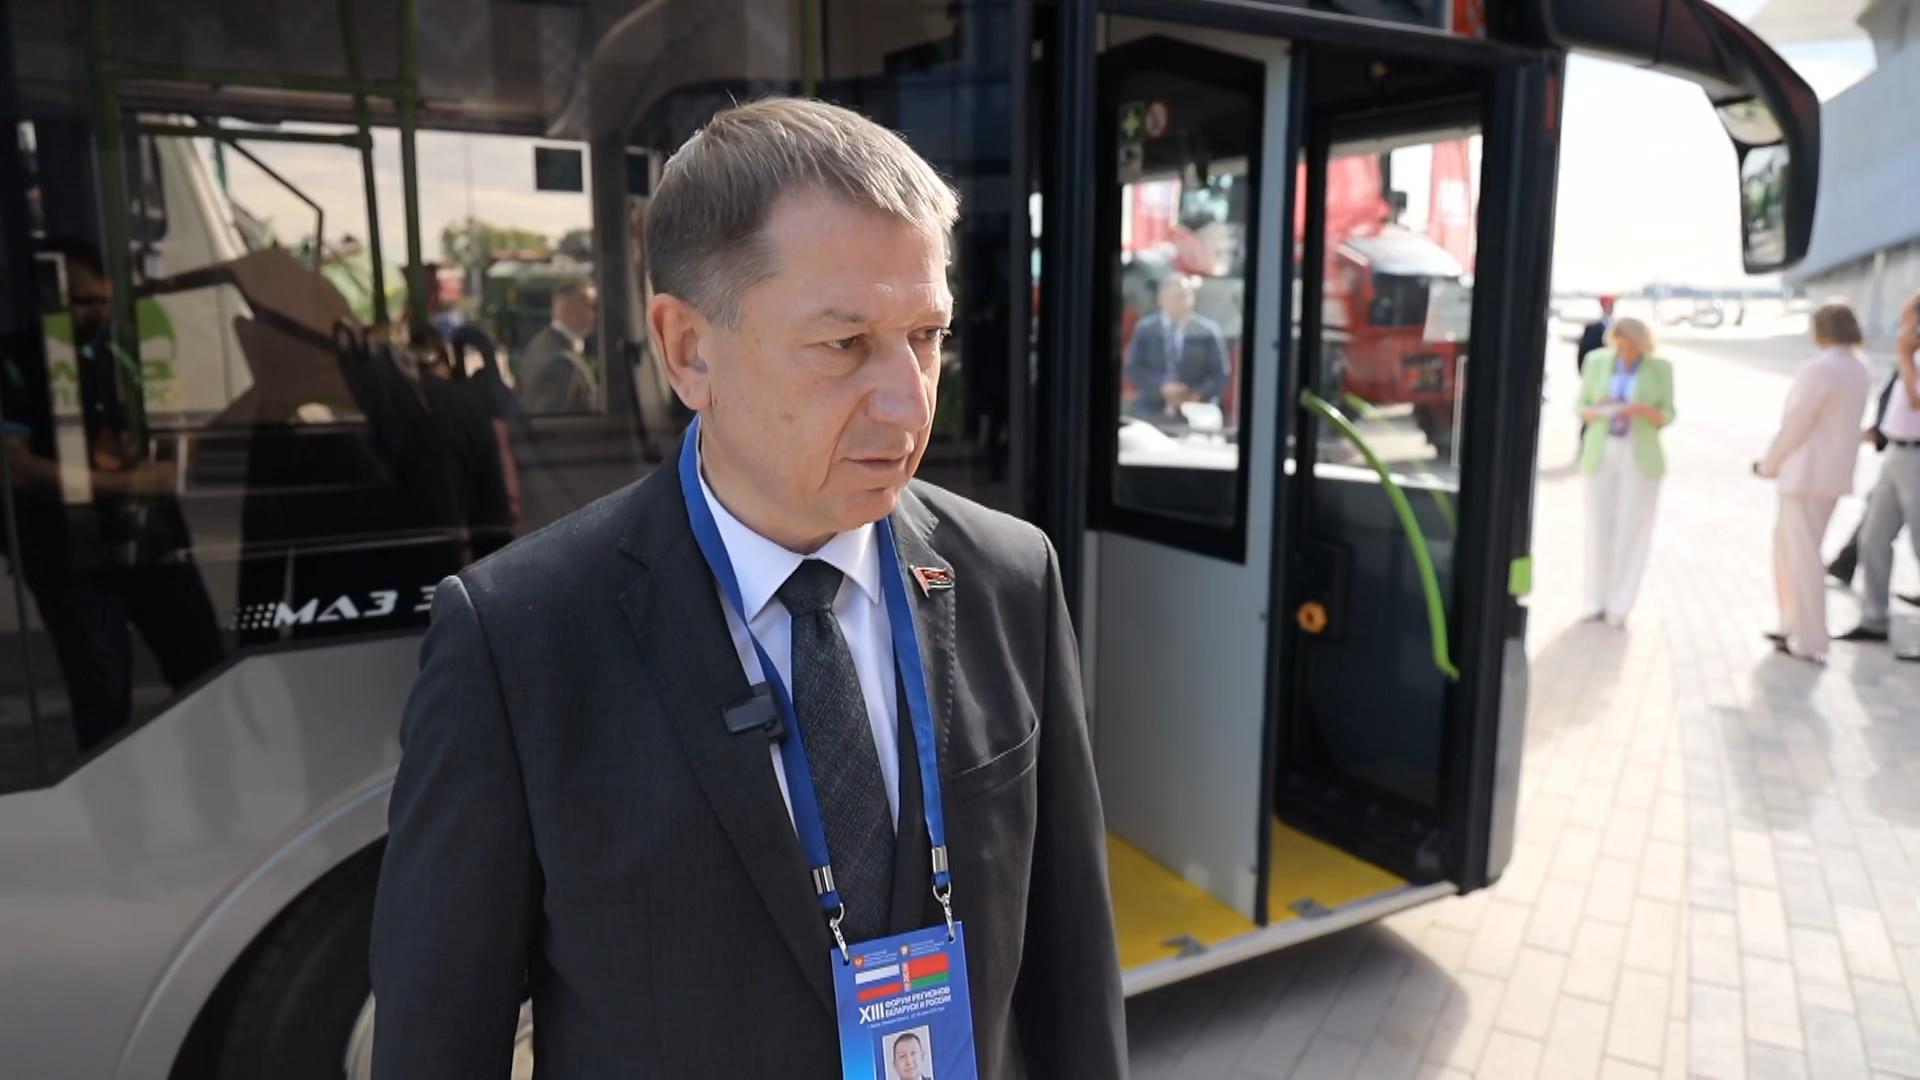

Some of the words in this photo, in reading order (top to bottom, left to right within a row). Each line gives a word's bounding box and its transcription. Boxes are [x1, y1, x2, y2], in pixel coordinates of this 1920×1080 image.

[273, 589, 399, 628] МАЗ
[859, 1002, 884, 1024] XIII
[885, 995, 912, 1009] ФОРУМ
[912, 987, 951, 1002] РЕГИОНОВ
[926, 995, 952, 1008] РОССИИ
